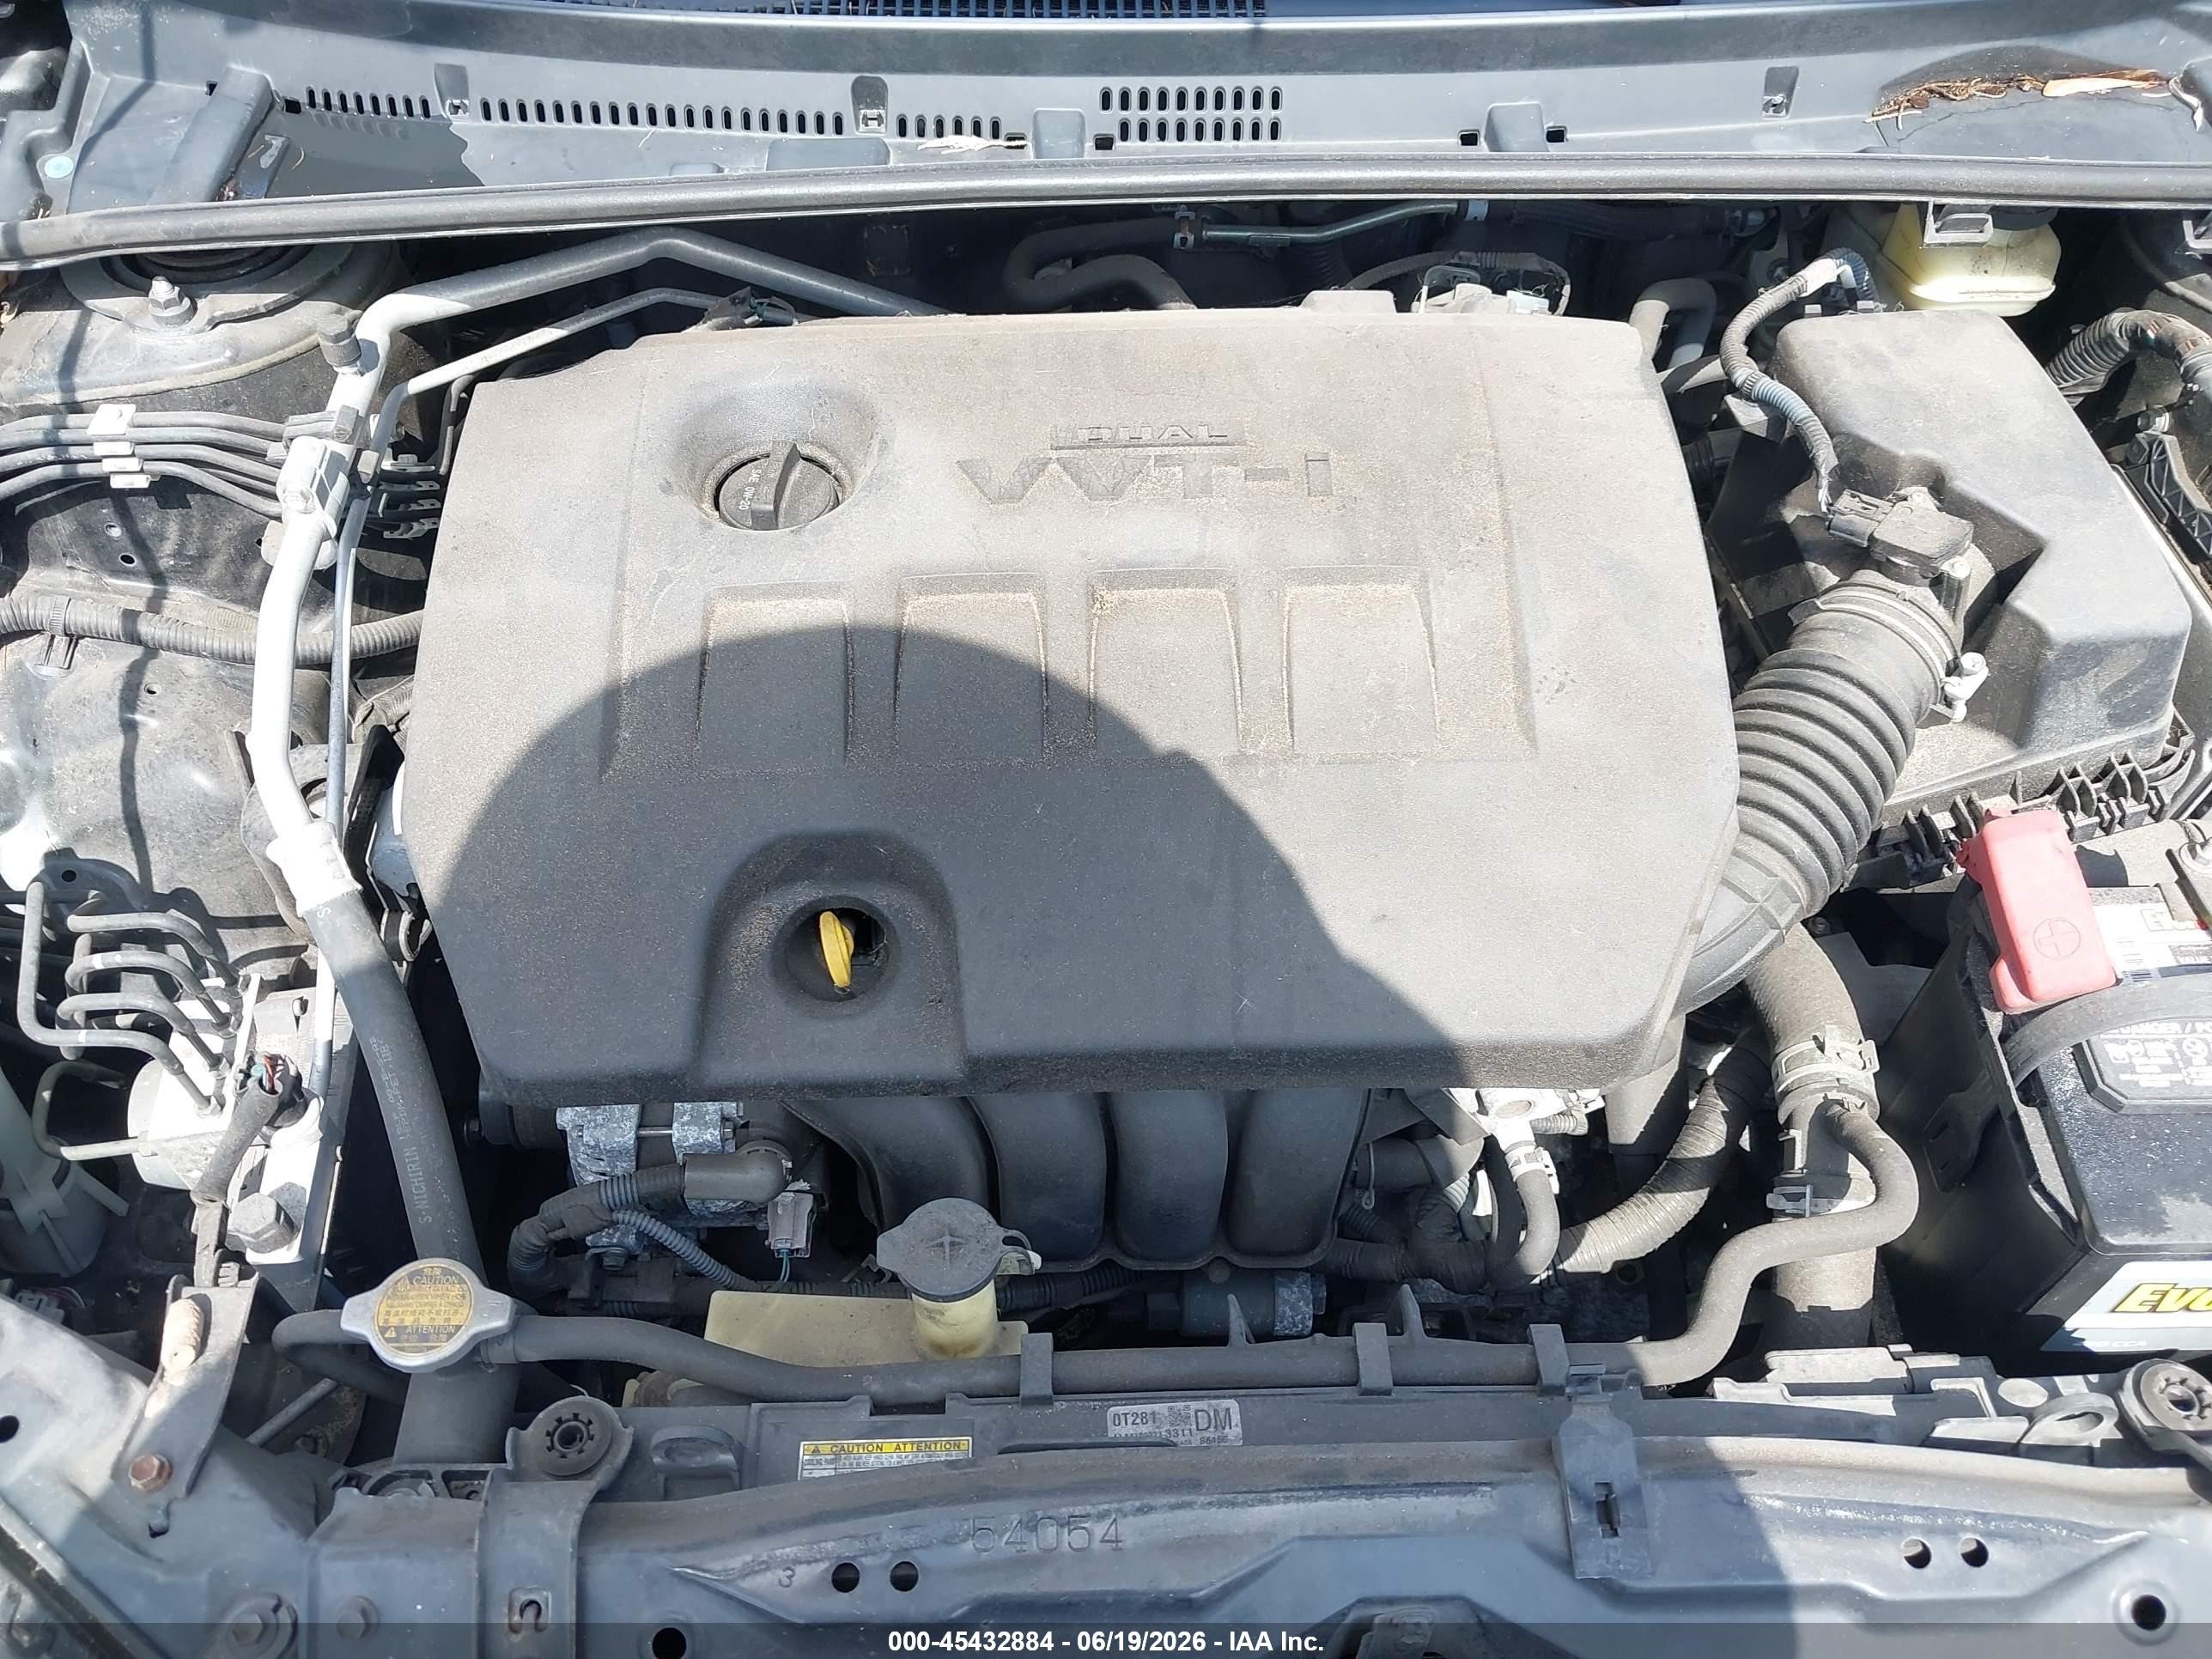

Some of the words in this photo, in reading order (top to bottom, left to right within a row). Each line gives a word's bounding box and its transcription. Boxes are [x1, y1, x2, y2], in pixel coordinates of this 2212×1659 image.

[748, 469, 762, 483] SAE
[738, 486, 756, 510] 0W-20
[413, 1275, 459, 1285] CAUTION
[405, 1325, 456, 1334] ATTENTION
[1194, 1407, 1233, 1432] DM
[830, 1443, 884, 1454] CAUTION
[894, 1441, 961, 1452] ATTENTION
[968, 1514, 1124, 1553] 54054
[778, 1565, 797, 1589] 3
